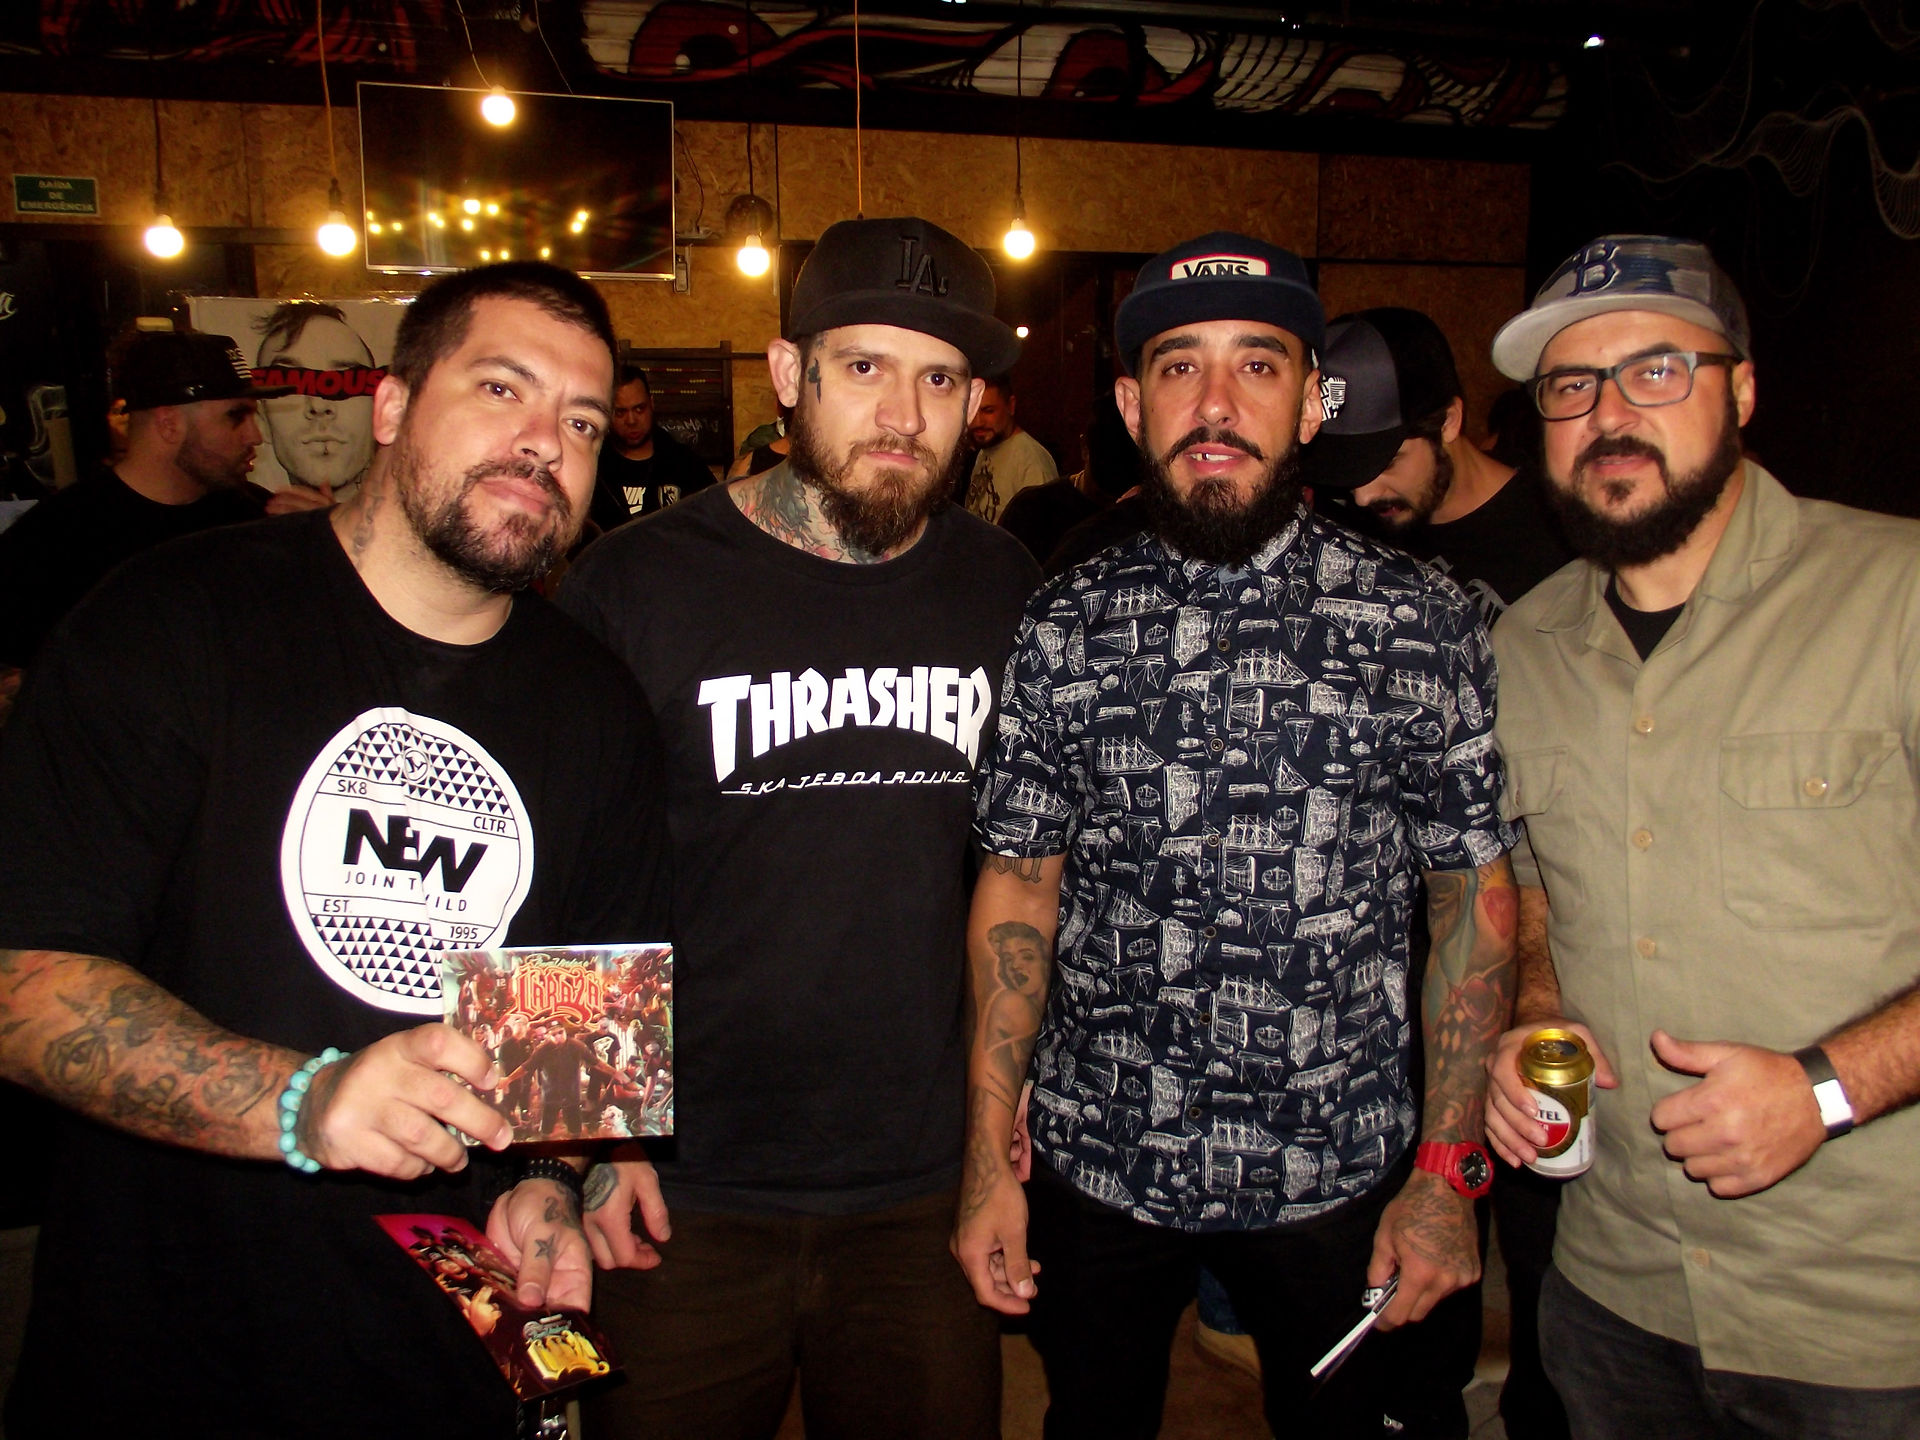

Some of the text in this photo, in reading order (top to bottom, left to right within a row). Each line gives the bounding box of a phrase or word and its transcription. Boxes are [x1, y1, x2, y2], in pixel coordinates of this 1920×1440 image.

[1183, 260, 1250, 278] VANS
[250, 369, 386, 395] FAMOUS
[697, 666, 991, 783] THRASHER
[337, 779, 368, 795] SK8
[473, 816, 507, 834] CLTR
[343, 808, 489, 894] NEW
[345, 871, 395, 889] JOIN
[450, 925, 479, 940] 1995
[496, 978, 507, 988] 12
[1538, 1109, 1562, 1122] TEL
